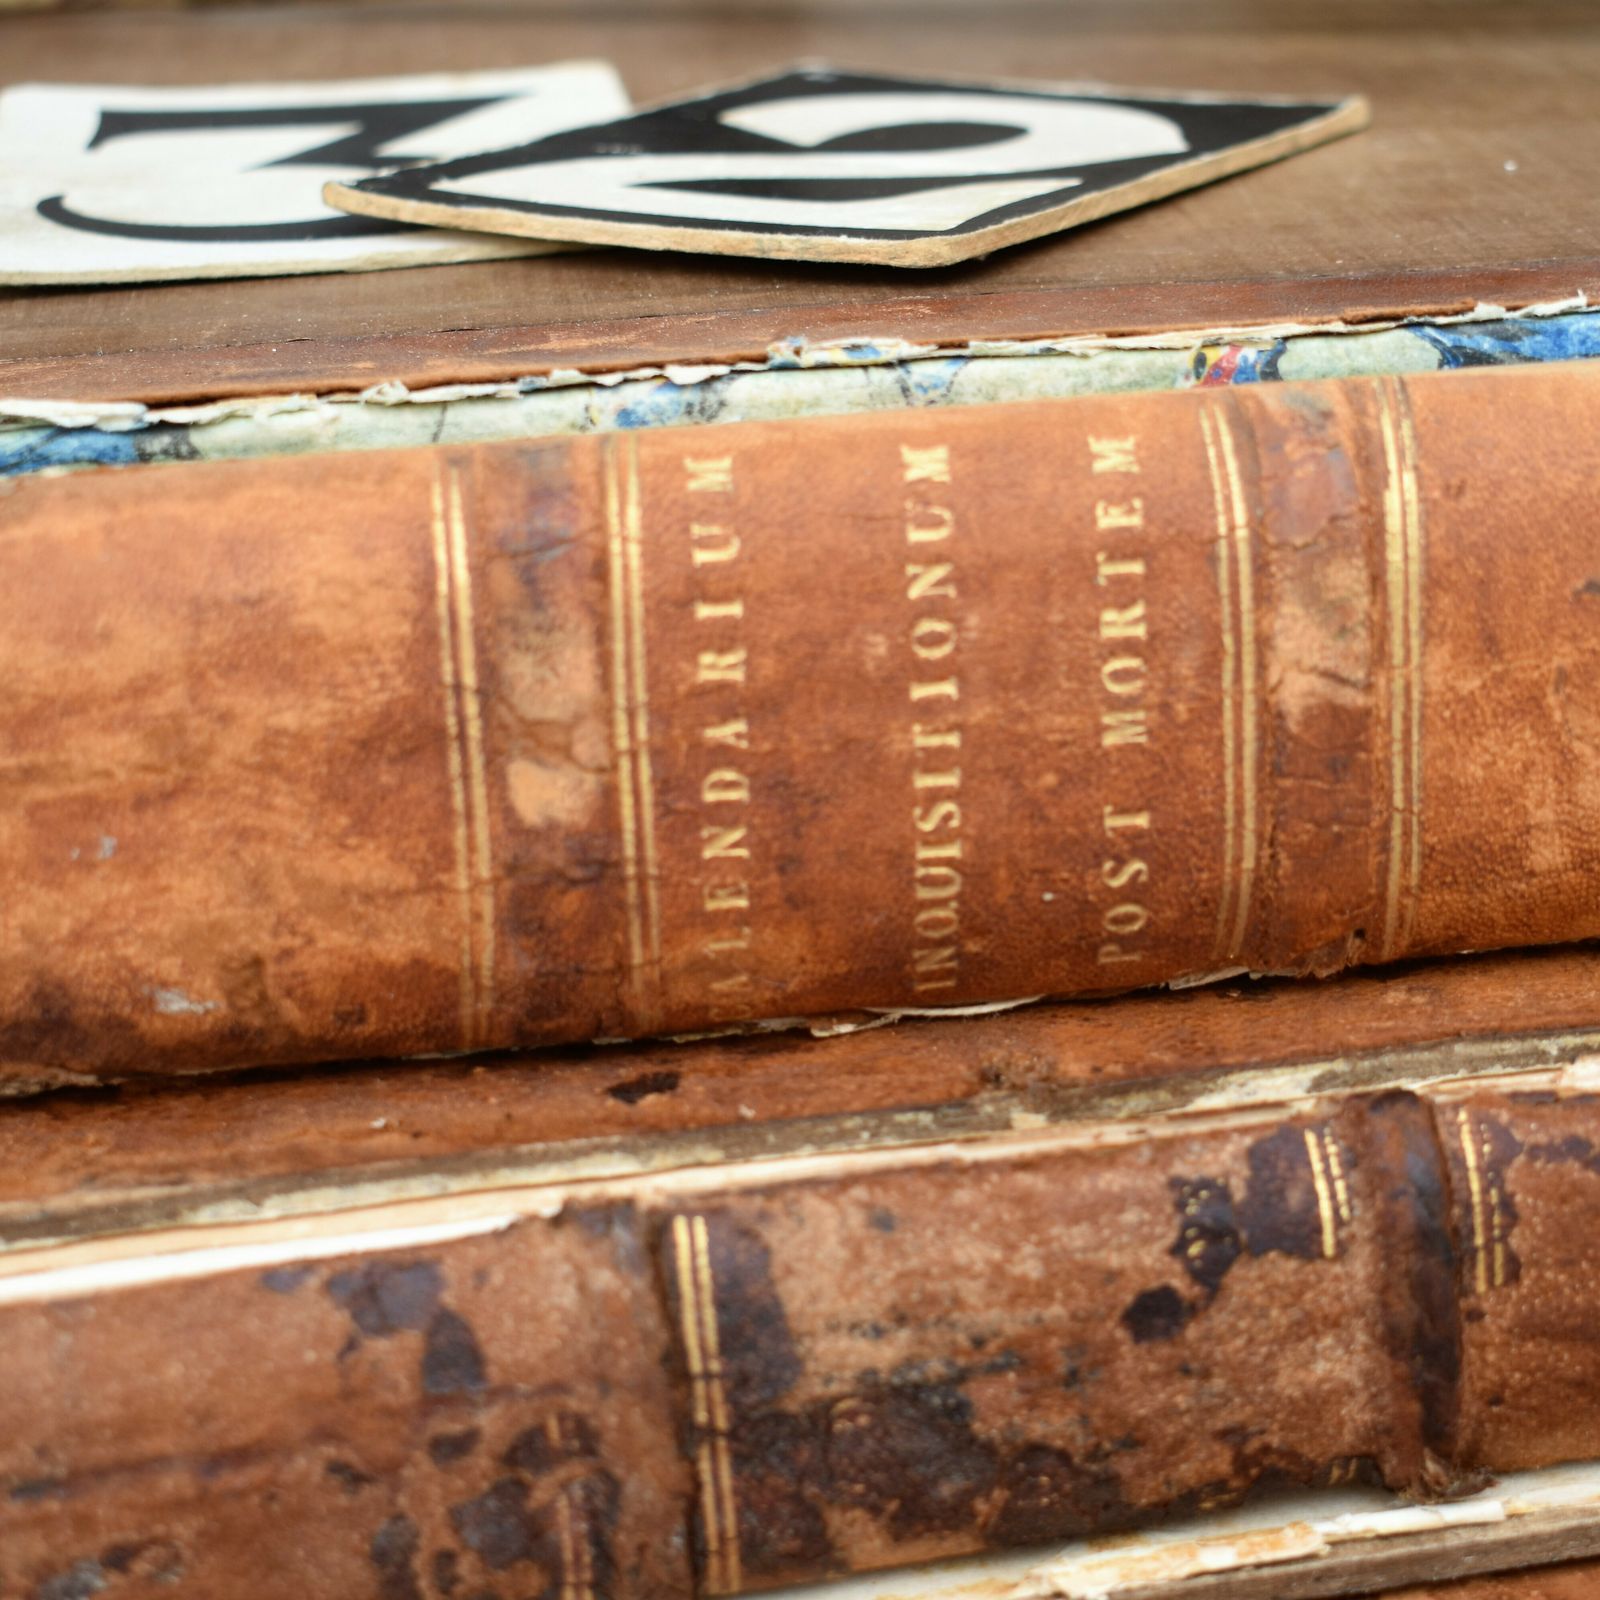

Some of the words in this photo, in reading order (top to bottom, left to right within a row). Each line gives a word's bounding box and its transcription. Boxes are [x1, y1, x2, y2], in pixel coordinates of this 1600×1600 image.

[38, 92, 530, 242] 3
[430, 95, 1190, 234] 2
[1088, 435, 1148, 750] MORTEM
[902, 445, 962, 993] INQUISITIONUM
[1096, 806, 1151, 965] POST
